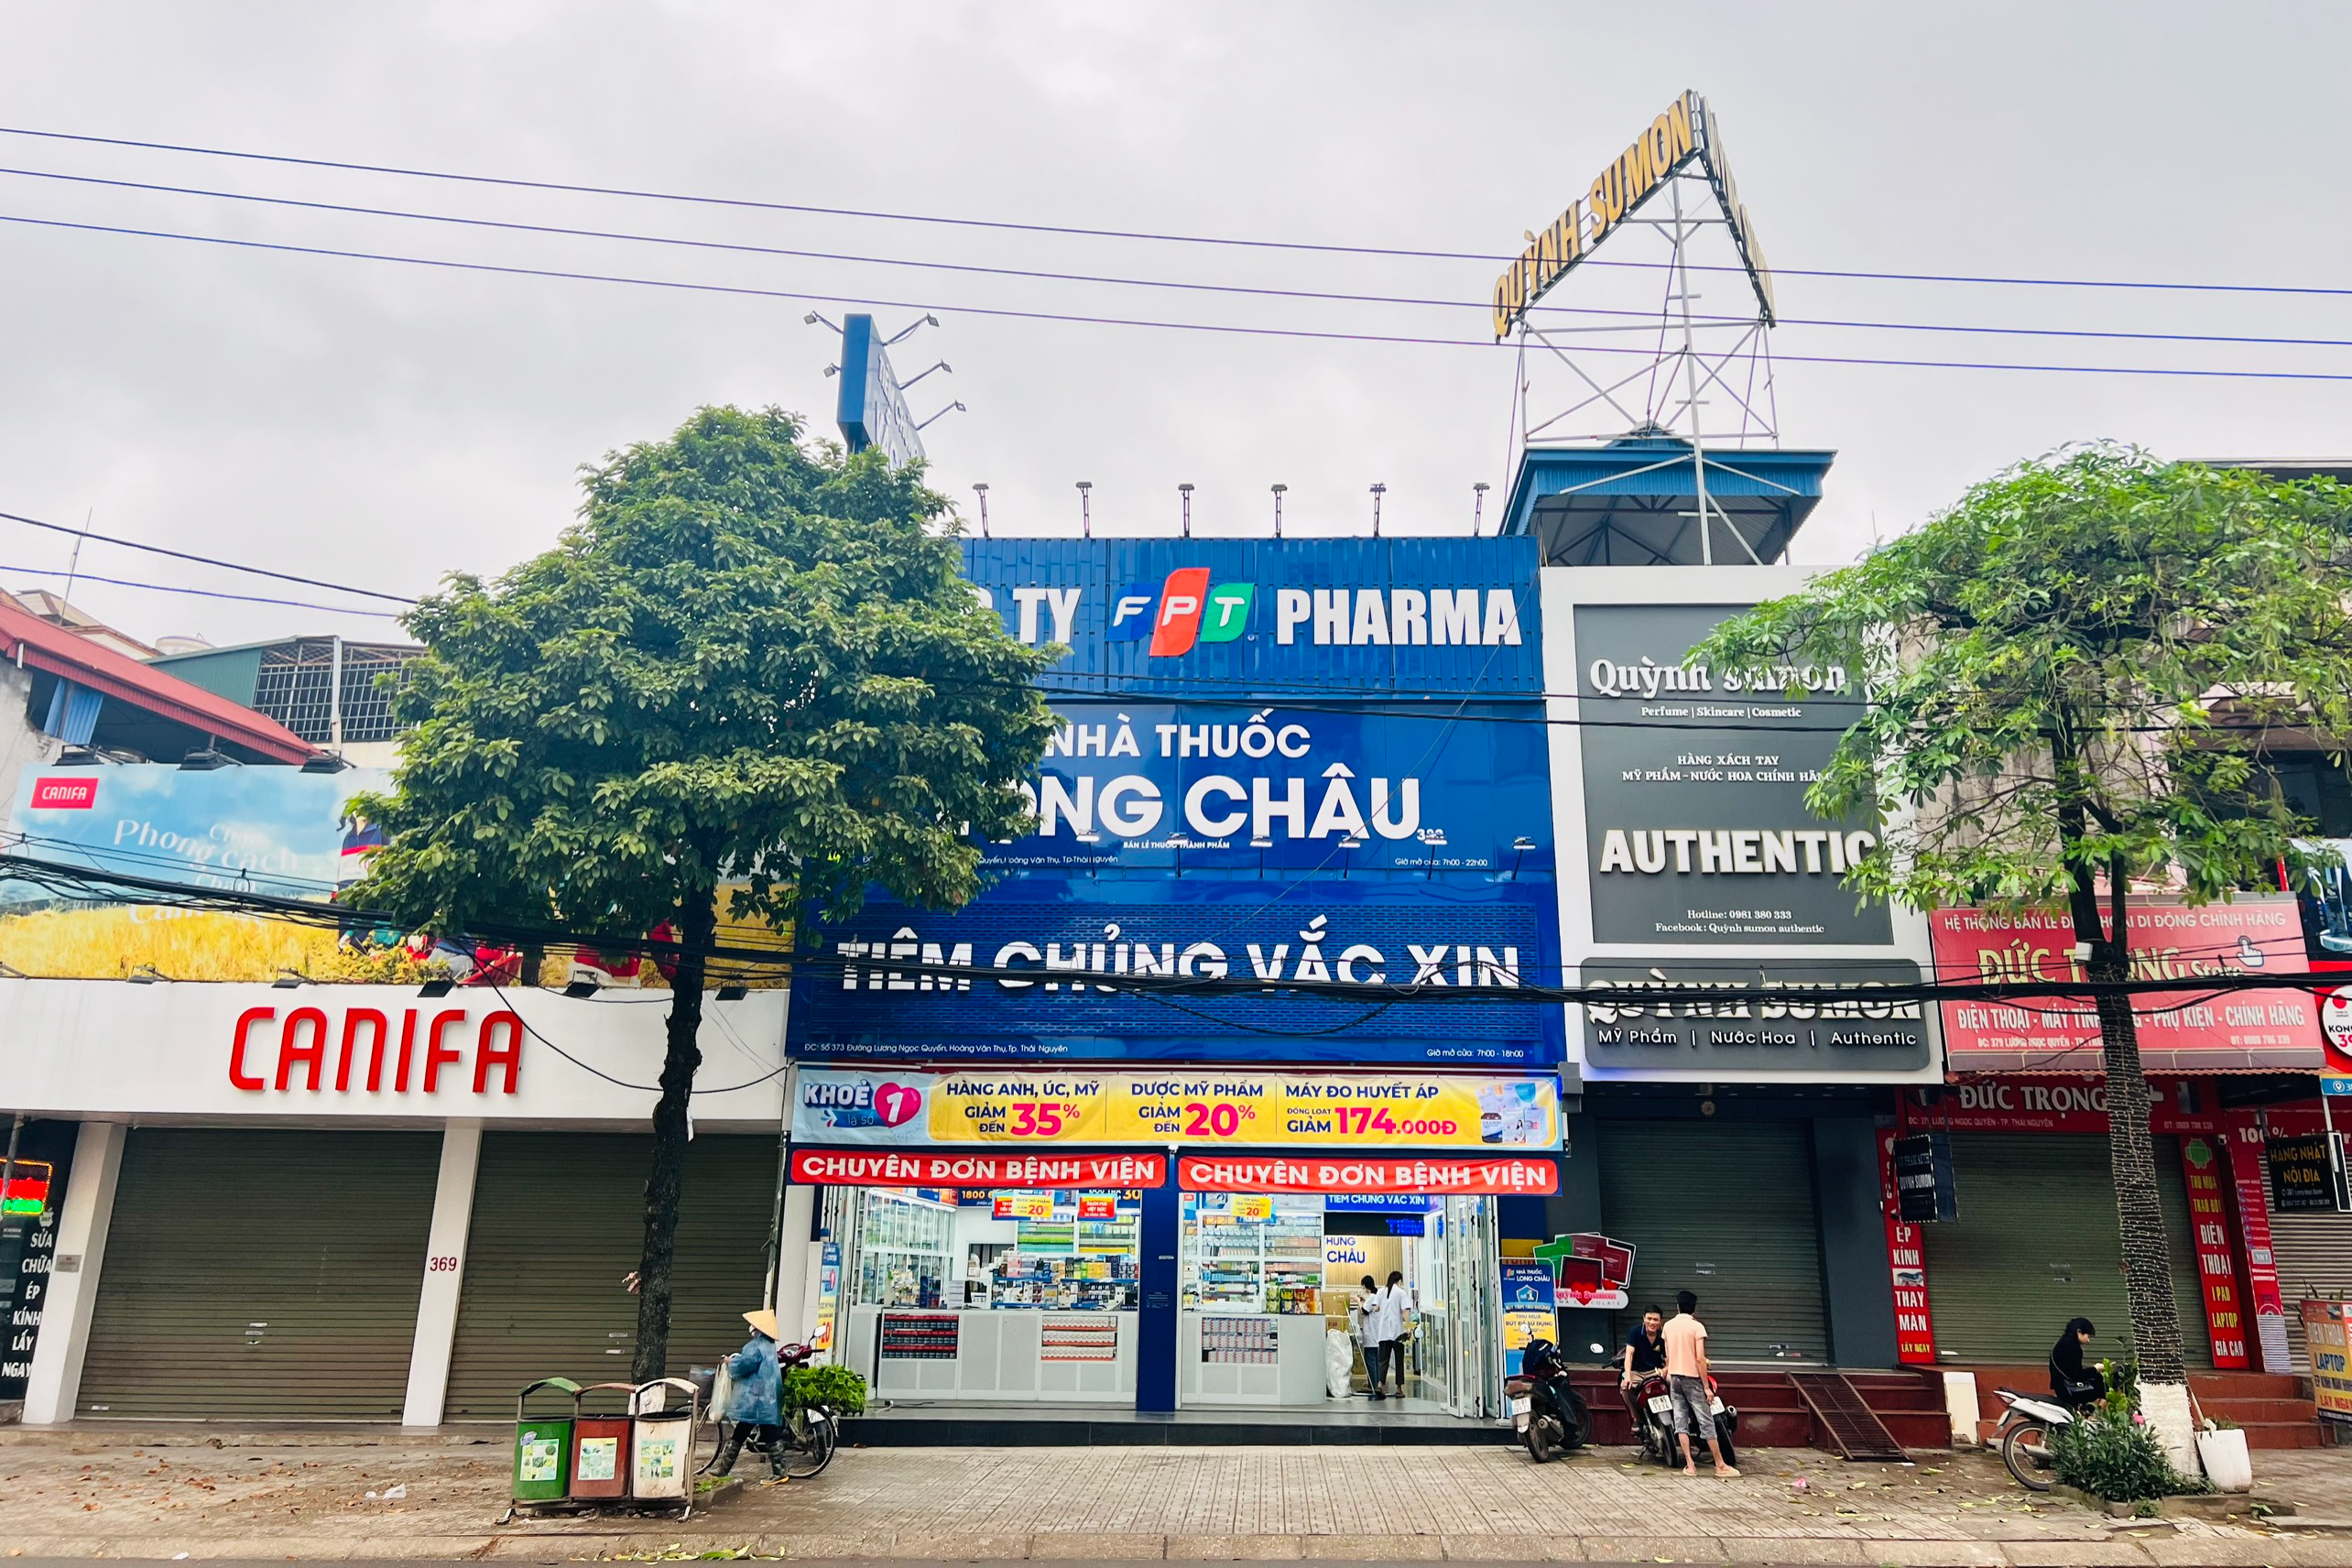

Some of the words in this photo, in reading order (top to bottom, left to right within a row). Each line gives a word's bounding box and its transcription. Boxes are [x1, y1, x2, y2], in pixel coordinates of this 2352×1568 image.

[1493, 200, 1584, 344] QUỲNH
[1590, 89, 1700, 245] SUMON
[1013, 588, 1082, 644] TY
[1277, 588, 1522, 646] PHARMA
[1589, 656, 1714, 699] Quỳnh
[1641, 706, 1689, 718] Perfume
[1696, 706, 1746, 718] Skincare
[1751, 707, 1802, 719] Cosmetic
[1044, 713, 1141, 758] NHÀ
[1156, 707, 1311, 758] THUỐC
[1677, 752, 1713, 766] HÀNG
[1716, 754, 1752, 767] XÁCH
[1755, 756, 1780, 766] TAY
[1622, 768, 1642, 781] MỸ
[1690, 767, 1724, 781] NƯỚC
[1727, 771, 1754, 781] HOA
[1756, 768, 1795, 782] CHÍNH
[41, 785, 89, 801] CANIFA
[1182, 763, 1421, 841] CHÂU
[114, 820, 216, 871] Phong
[1599, 828, 1878, 874] AUTHENTIC
[1465, 858, 1488, 866] 22h00
[1687, 909, 1728, 920] Hotline:
[1774, 909, 1792, 920] 333
[1944, 914, 1962, 931] HỆ
[2137, 916, 2151, 928] DI
[2154, 912, 2197, 931] ĐỘNG
[2200, 911, 2243, 928] CHÍNH
[2247, 910, 2287, 927] HÃNG
[1656, 922, 1708, 933] Facebook:
[1709, 922, 1743, 935] Quỳnh
[1744, 925, 1777, 934] sumon
[1779, 923, 1824, 934] authentic
[837, 927, 973, 991] TIÊM
[1246, 914, 1388, 992] VẮC
[1407, 944, 1520, 989] XIN
[1977, 938, 2056, 985] ĐỨC
[2063, 947, 2186, 984] TNG
[1957, 1003, 1989, 1033] ĐIỆN
[1991, 1007, 2031, 1033] THOẠI
[2182, 1005, 2216, 1031] KIỆN
[2225, 1000, 2266, 1028] CHÍNH
[2269, 1000, 2305, 1027] HÃNG
[1630, 1027, 1677, 1044] Phẩm
[1711, 1029, 1757, 1045] Nước
[1762, 1031, 1796, 1045] Hoa
[1831, 1030, 1918, 1046] Authentic
[2327, 1025, 2352, 1033] KON
[229, 1006, 524, 1094] CANIFA
[832, 1043, 844, 1051] 373
[874, 1043, 897, 1052] Lương
[898, 1044, 920, 1053] Ngọc
[949, 1043, 975, 1053] Hoàng
[975, 1043, 992, 1052] Văn
[1020, 1043, 1036, 1052] Thái
[1039, 1044, 1068, 1053] Nguyên
[1476, 1049, 1496, 1058] 7h00
[1501, 1049, 1524, 1058] 18h00
[946, 1080, 996, 1097] HÀNG
[997, 1083, 1039, 1098] ANH,
[1042, 1078, 1071, 1098] ÚC,
[1074, 1079, 1100, 1096] MỸ
[1131, 1082, 1181, 1099] DƯỢC
[1184, 1080, 1211, 1097] MỸ
[1214, 1078, 1263, 1097] PHẨM
[1286, 1081, 1323, 1098] MÁY
[1326, 1085, 1353, 1099] ĐO
[1357, 1079, 1412, 1099] HUYẾT
[1415, 1082, 1439, 1099] ÁP
[886, 1091, 905, 1124] 1
[1959, 1079, 2015, 1110] ĐỨC
[2020, 1086, 2107, 1119] TRỌNG
[964, 1101, 1007, 1118] GIẢM
[1010, 1103, 1081, 1137] 35%
[979, 1117, 1006, 1134] ĐẾN
[1138, 1102, 1181, 1119] GIẢM
[1185, 1103, 1256, 1137] 20%
[1154, 1117, 1181, 1134] ĐẾN
[1287, 1115, 1332, 1134] GIẢM
[1334, 1106, 1457, 1136] 174.000Đ
[2270, 1143, 2298, 1162] HÀNG
[2300, 1140, 2326, 1164] NHẬT
[802, 1154, 921, 1179] CHUYÊN
[930, 1157, 996, 1181] ĐƠN
[1007, 1156, 1081, 1185] BỆNH
[1090, 1156, 1155, 1186] VIỆN
[1190, 1160, 1308, 1184] CHUYÊN
[1319, 1162, 1386, 1186] ĐƠN
[1395, 1161, 1471, 1191] BỆNH
[1480, 1160, 1547, 1192] VIỆN
[1410, 1195, 1425, 1205] XIN
[2200, 1220, 2225, 1249] ĐIỆN
[430, 1257, 457, 1271] 369
[1327, 1248, 1366, 1263] CHÂU
[1893, 1247, 1920, 1266] KÍNH
[2202, 1254, 2232, 1279] THOẠI
[26, 1283, 40, 1301] ÉP
[1895, 1290, 1924, 1308] THAY
[1899, 1312, 1927, 1332] MÀN
[2212, 1312, 2238, 1328] LAPTOP
[2314, 1352, 2345, 1372] LAPTOP
